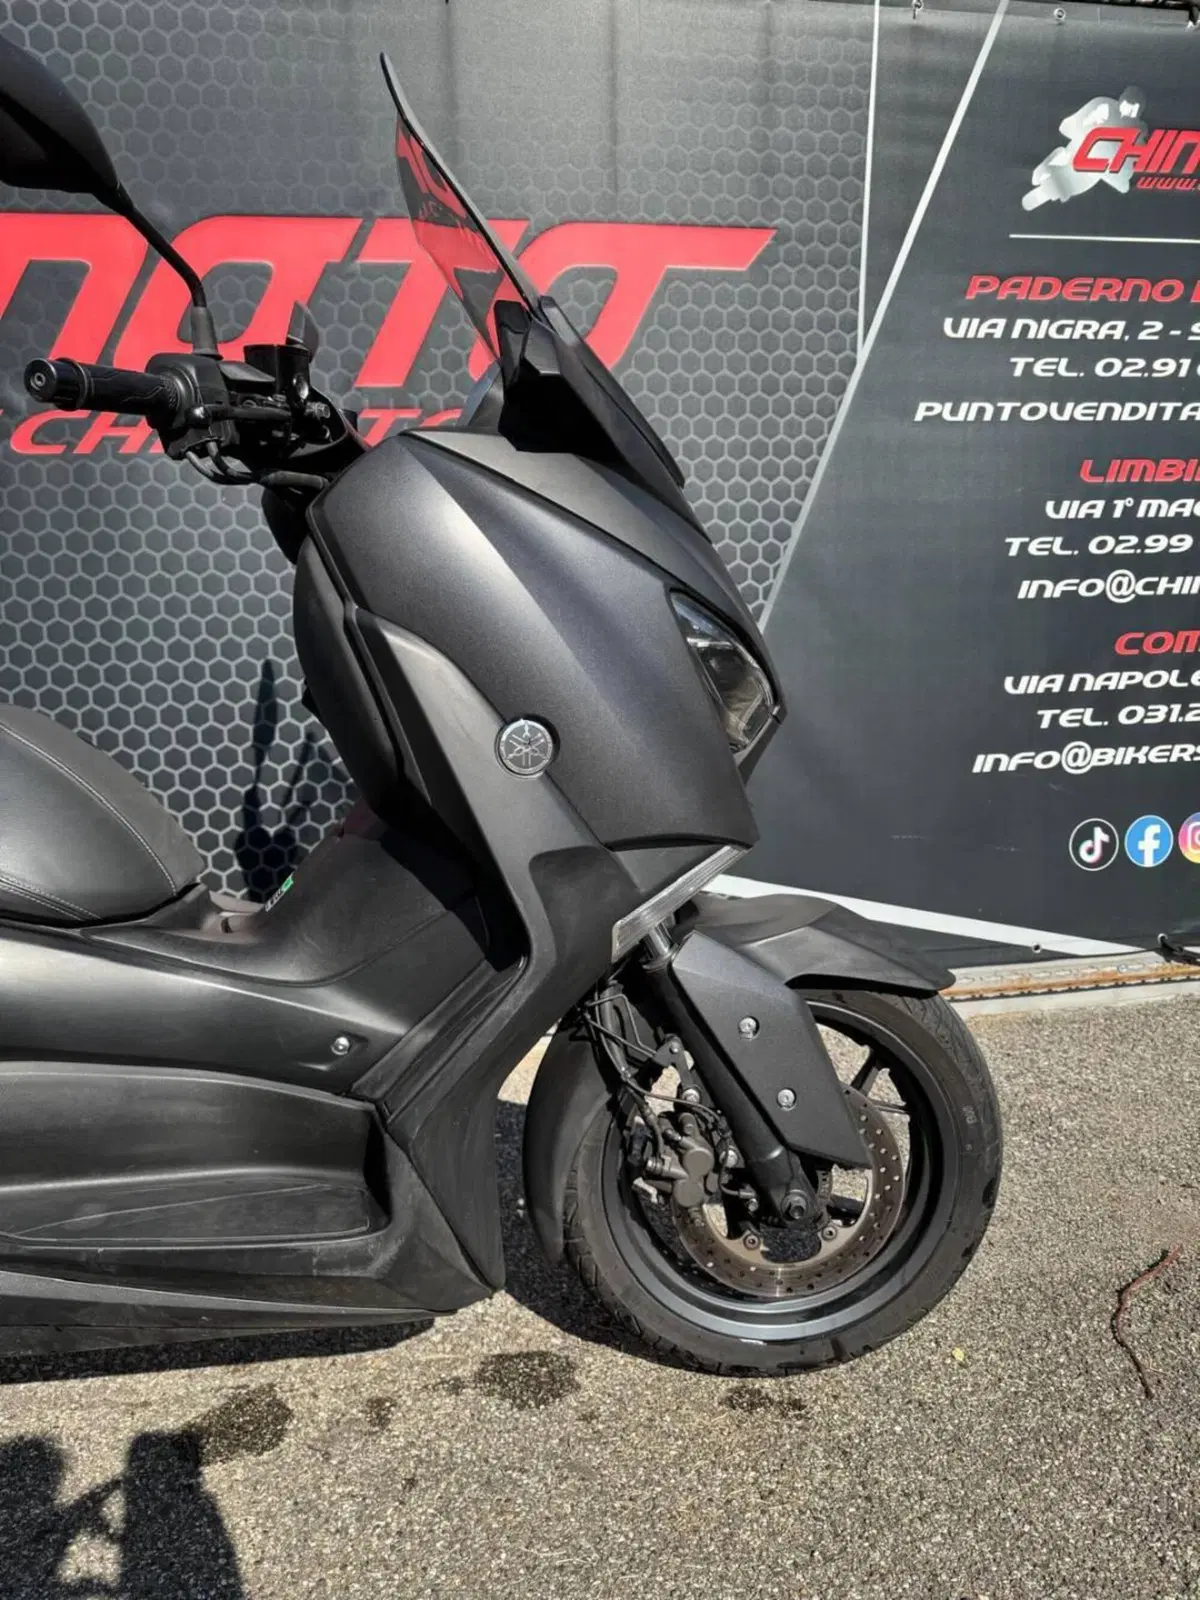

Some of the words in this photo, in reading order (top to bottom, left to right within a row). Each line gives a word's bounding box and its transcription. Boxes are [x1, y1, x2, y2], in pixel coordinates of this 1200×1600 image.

[966, 276, 1183, 301] PADERNO
[944, 317, 1007, 338] VIA
[1011, 319, 1129, 340] NIGRA,
[1138, 321, 1163, 340] 2
[1010, 358, 1084, 377] TEL.
[1095, 358, 1191, 377] 02.91
[1081, 459, 1200, 481] LIMBI
[1046, 500, 1105, 518] VIA
[1088, 534, 1193, 554] 02.99
[1004, 674, 1064, 694] VIA
[1038, 708, 1108, 728] TEL.
